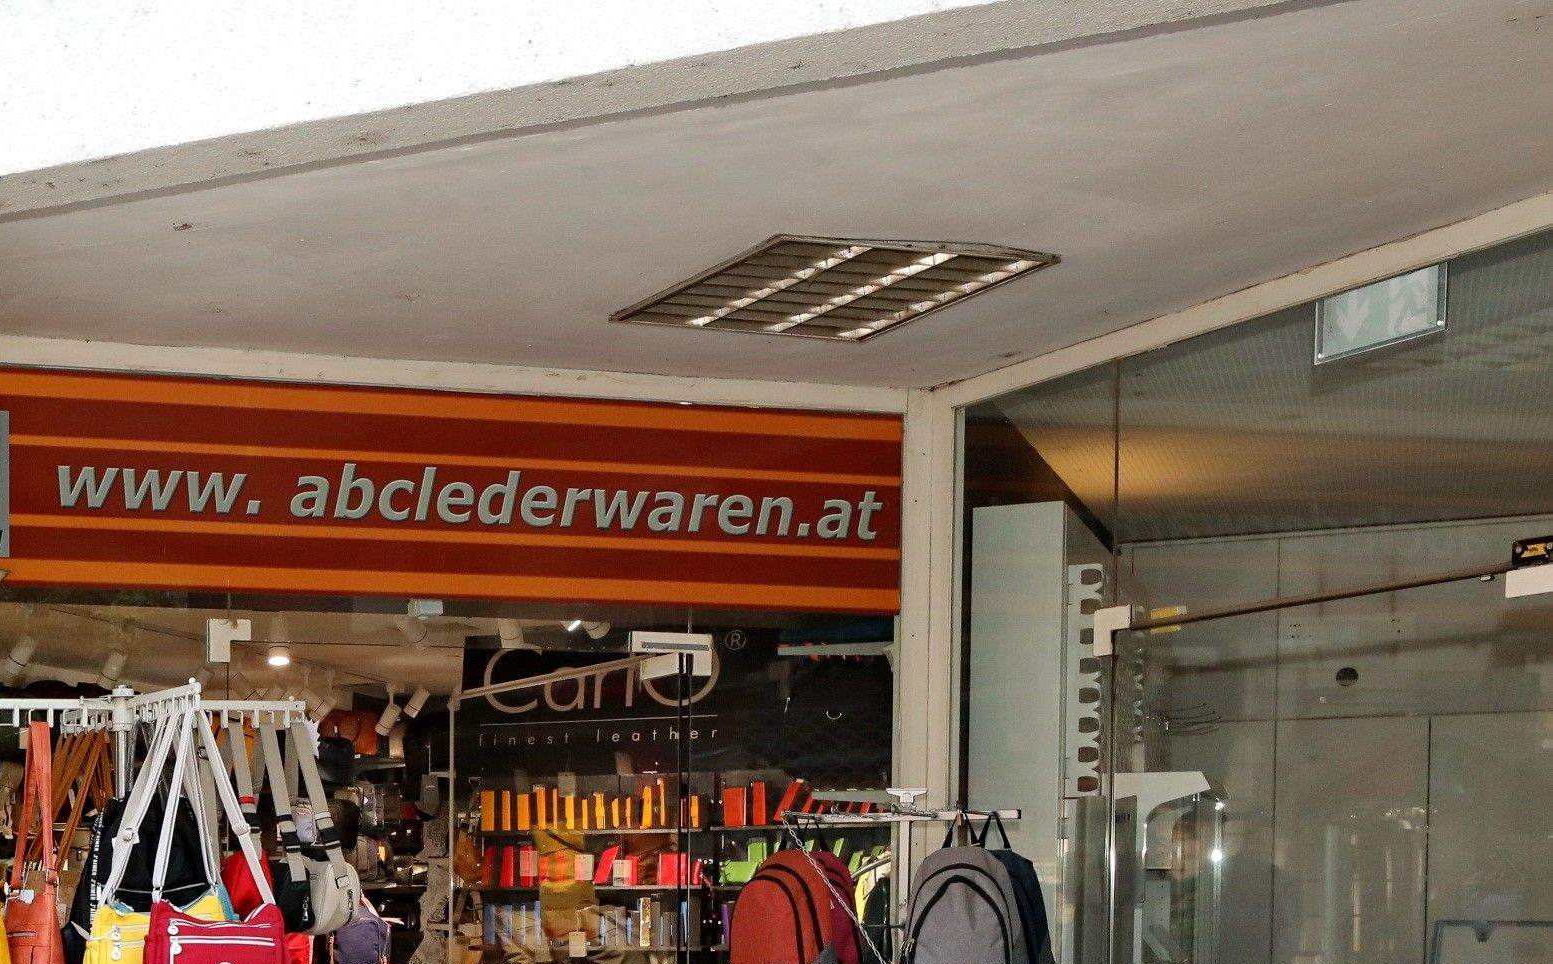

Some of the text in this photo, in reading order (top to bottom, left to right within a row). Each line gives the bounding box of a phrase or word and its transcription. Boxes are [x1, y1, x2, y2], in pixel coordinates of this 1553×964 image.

[289, 462, 884, 542] abclederwaren.at
[478, 726, 719, 748] finest leather
